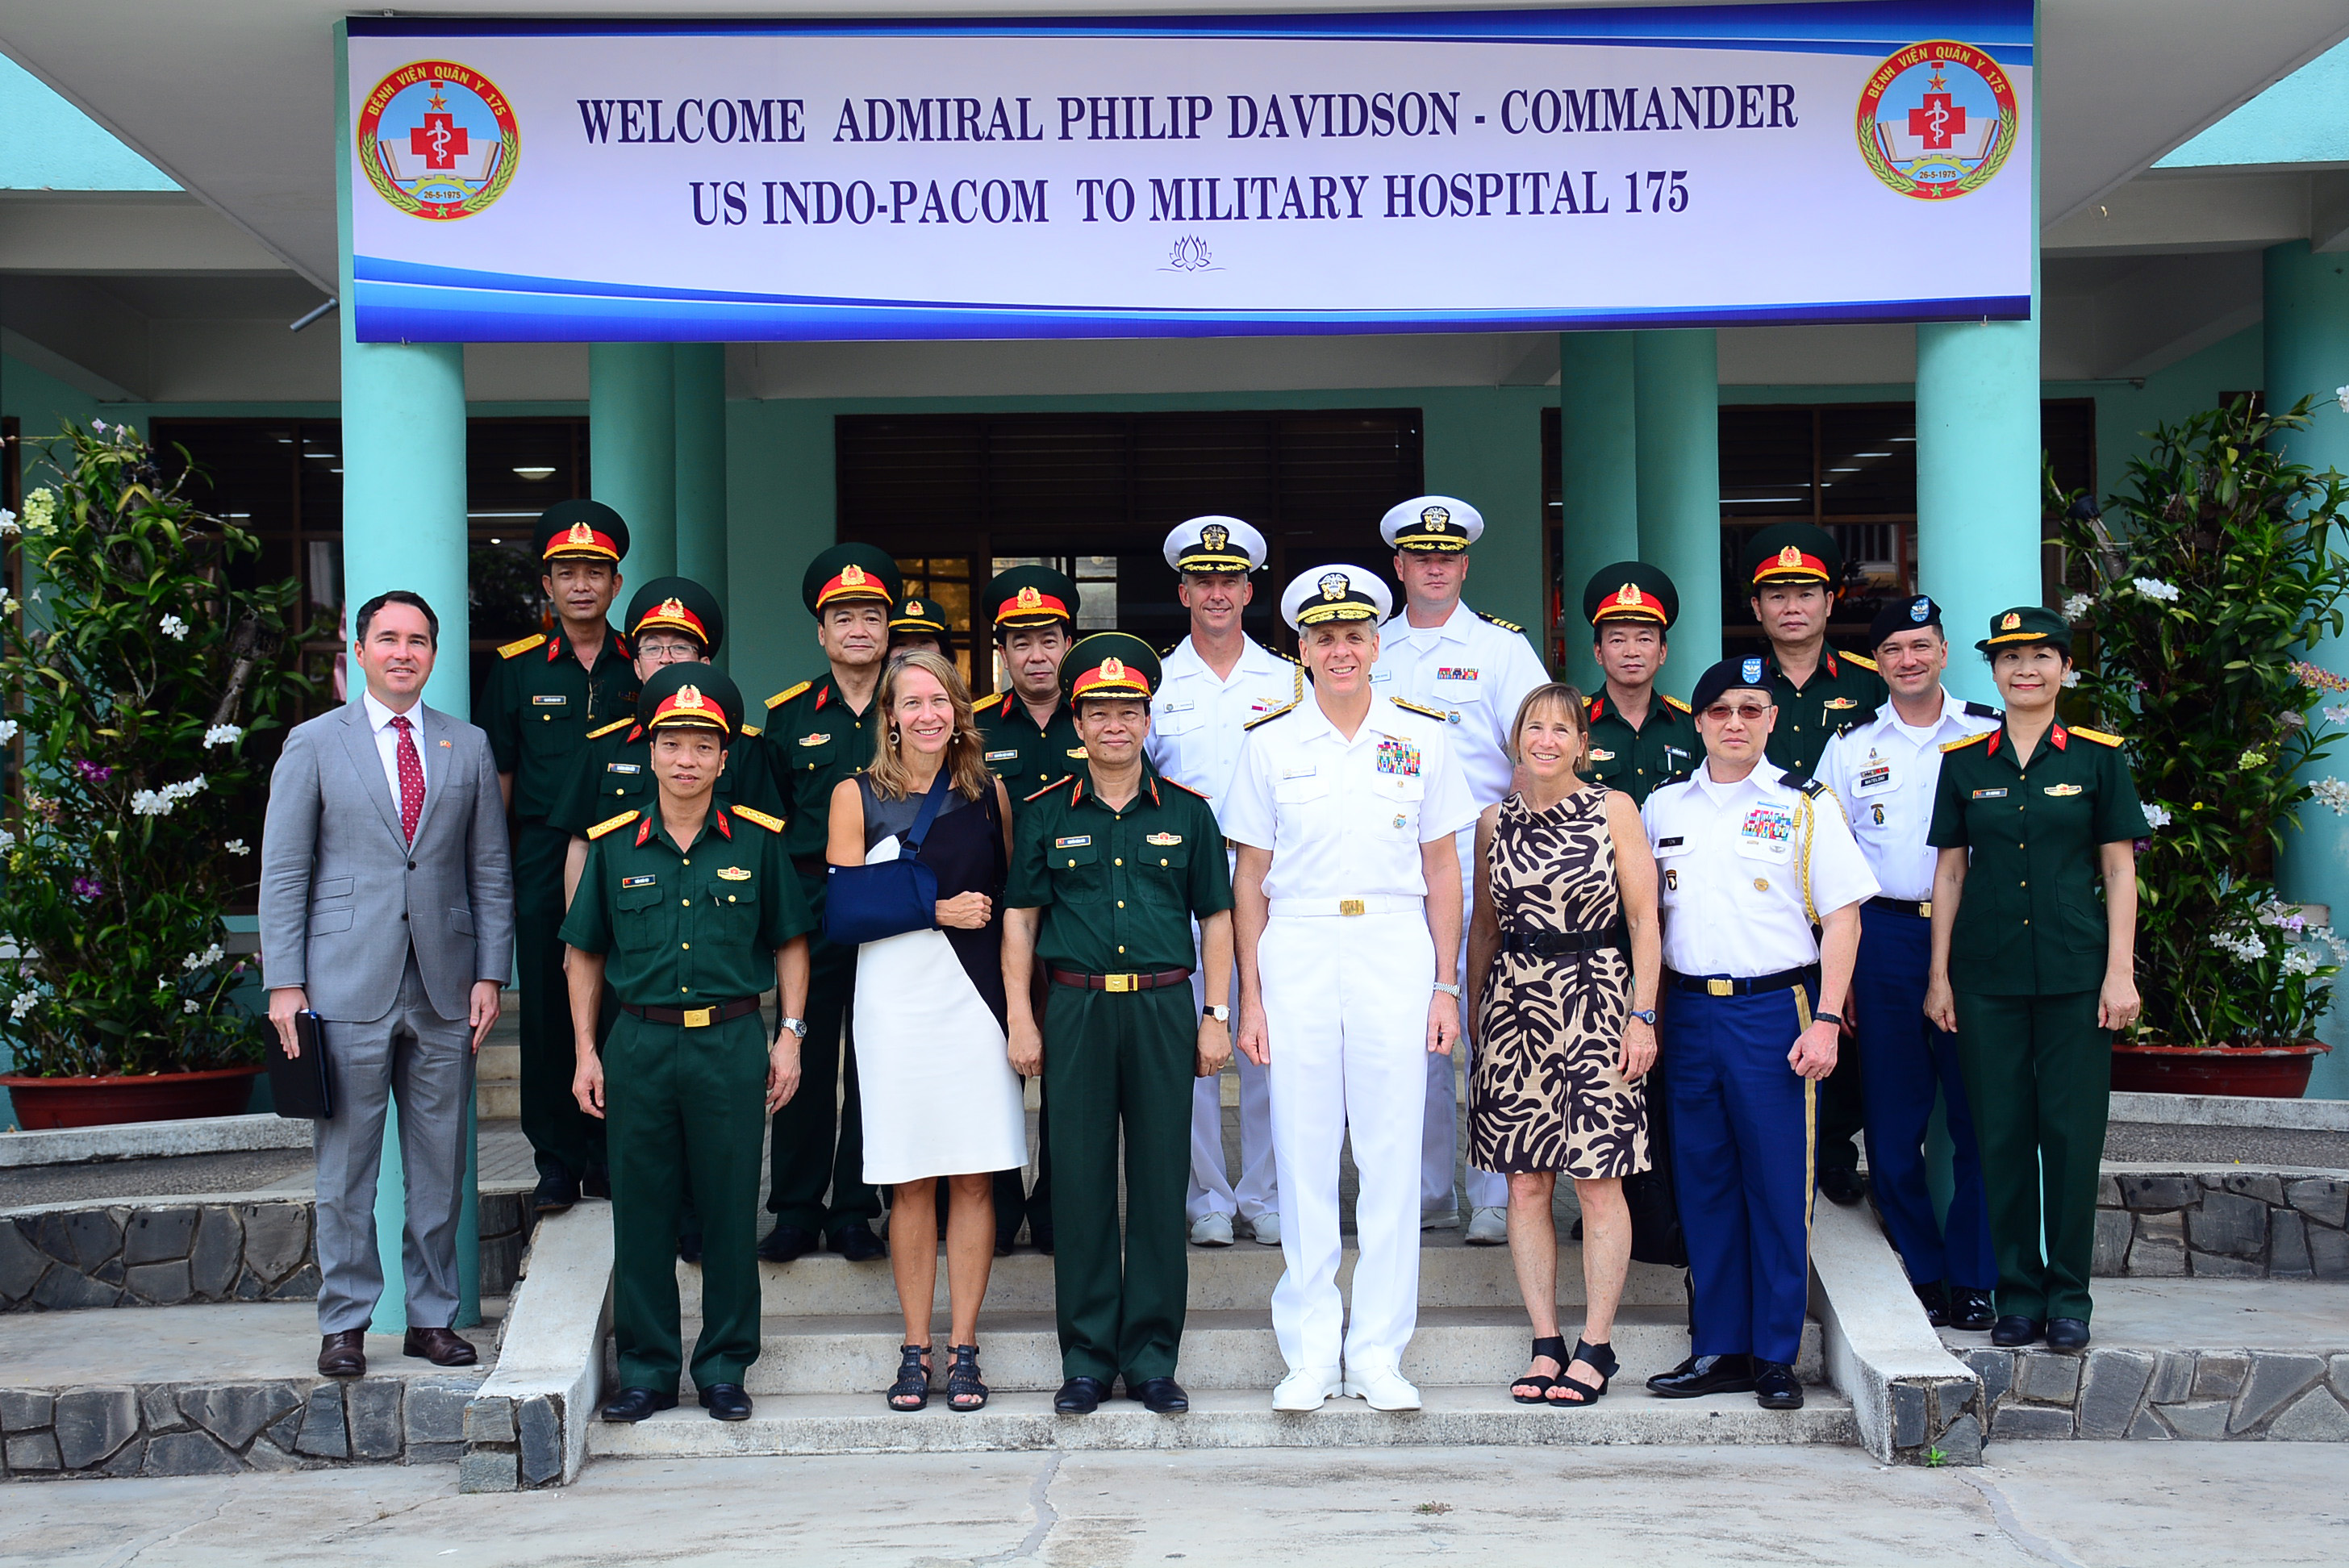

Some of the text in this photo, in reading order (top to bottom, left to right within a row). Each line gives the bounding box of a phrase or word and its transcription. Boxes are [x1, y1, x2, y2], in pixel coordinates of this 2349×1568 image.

[367, 65, 507, 117] BỆNH VIỆN QUÂN Y 175
[1867, 46, 2006, 99] BỆNH VIỆN QUÂN Y 175
[577, 84, 1799, 144] WELCOME ADMIRAL PHILIP DAVIDSON - COMMANDER
[423, 191, 461, 199] 26-5-1975
[689, 170, 1689, 226] US INDO-PACOM TO MILITARY HOSPITAL 175
[1919, 171, 1956, 179] 26-5-1975
